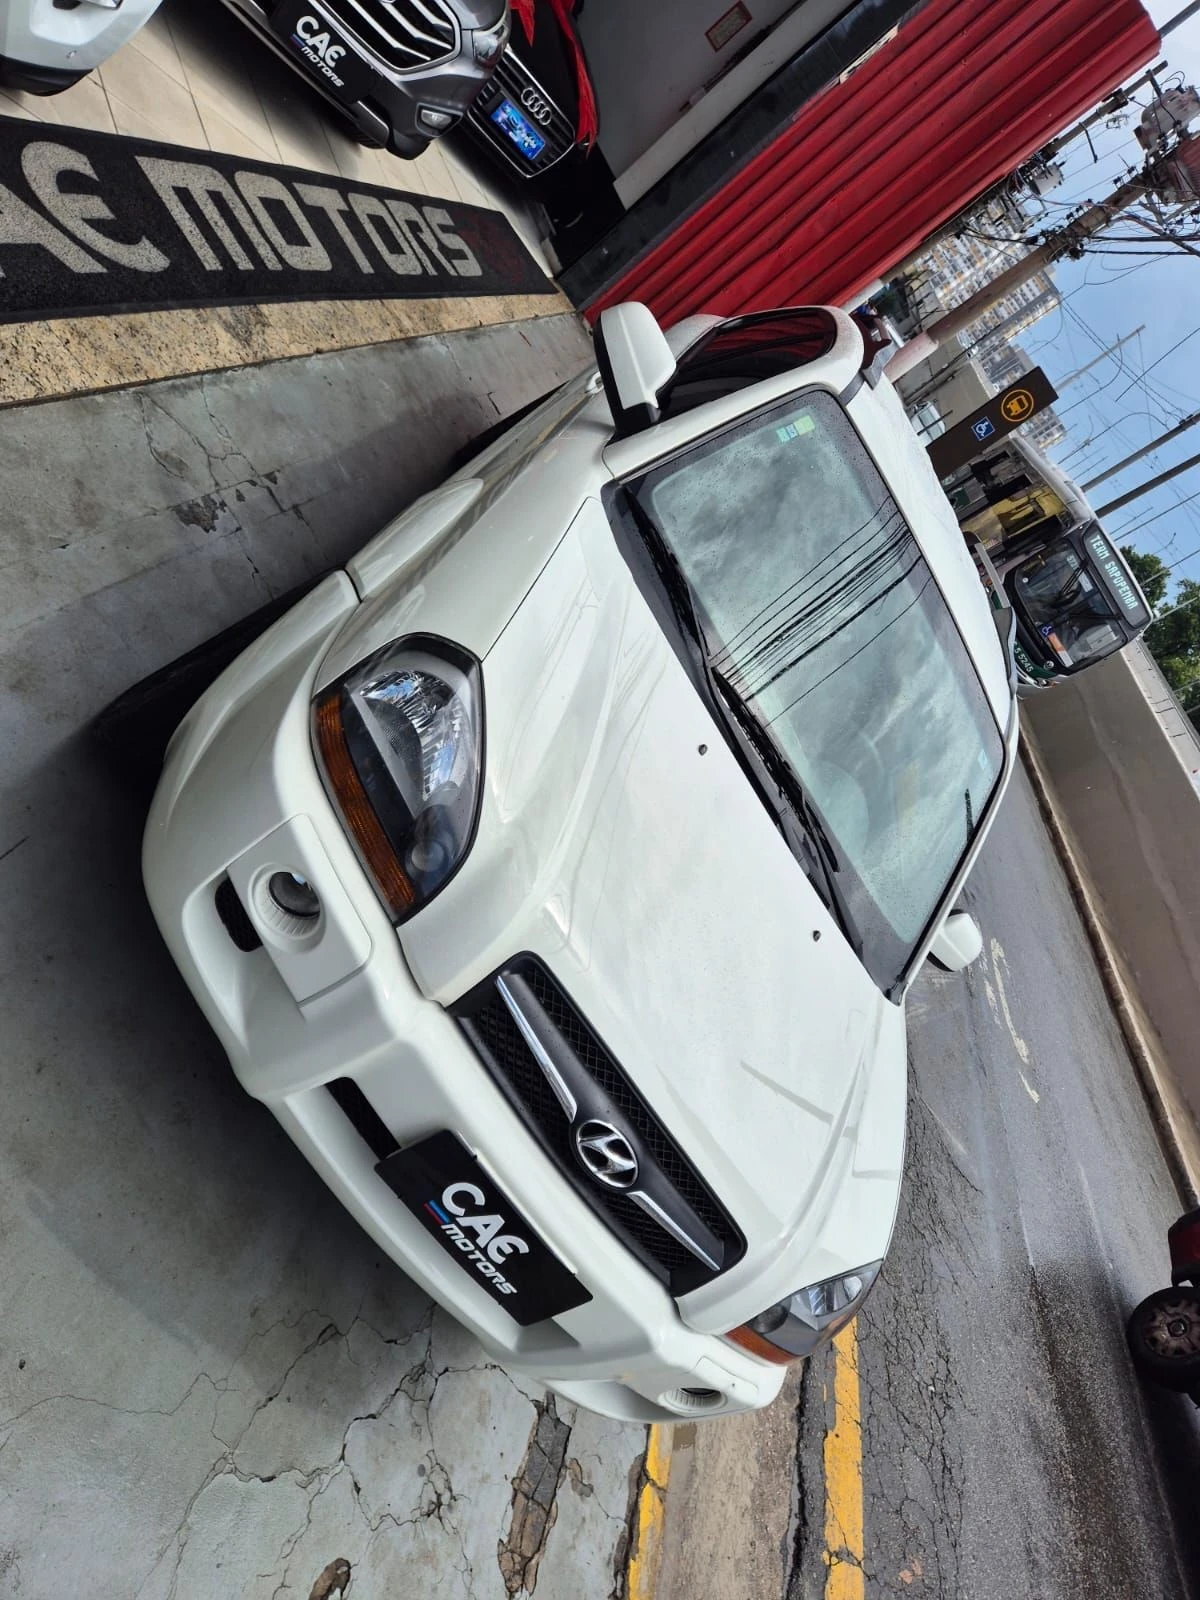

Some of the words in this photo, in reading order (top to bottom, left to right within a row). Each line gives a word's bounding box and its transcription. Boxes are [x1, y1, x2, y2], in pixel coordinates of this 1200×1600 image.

[296, 15, 346, 68] CAE
[301, 46, 345, 87] MOTORS
[135, 155, 482, 277] MOTORS
[1090, 534, 1110, 560] TERM
[1104, 560, 1138, 610] SAPOPEMBA
[1018, 653, 1034, 672] 5245
[441, 1223, 518, 1294] MOTORS
[442, 1182, 529, 1264] CAE
